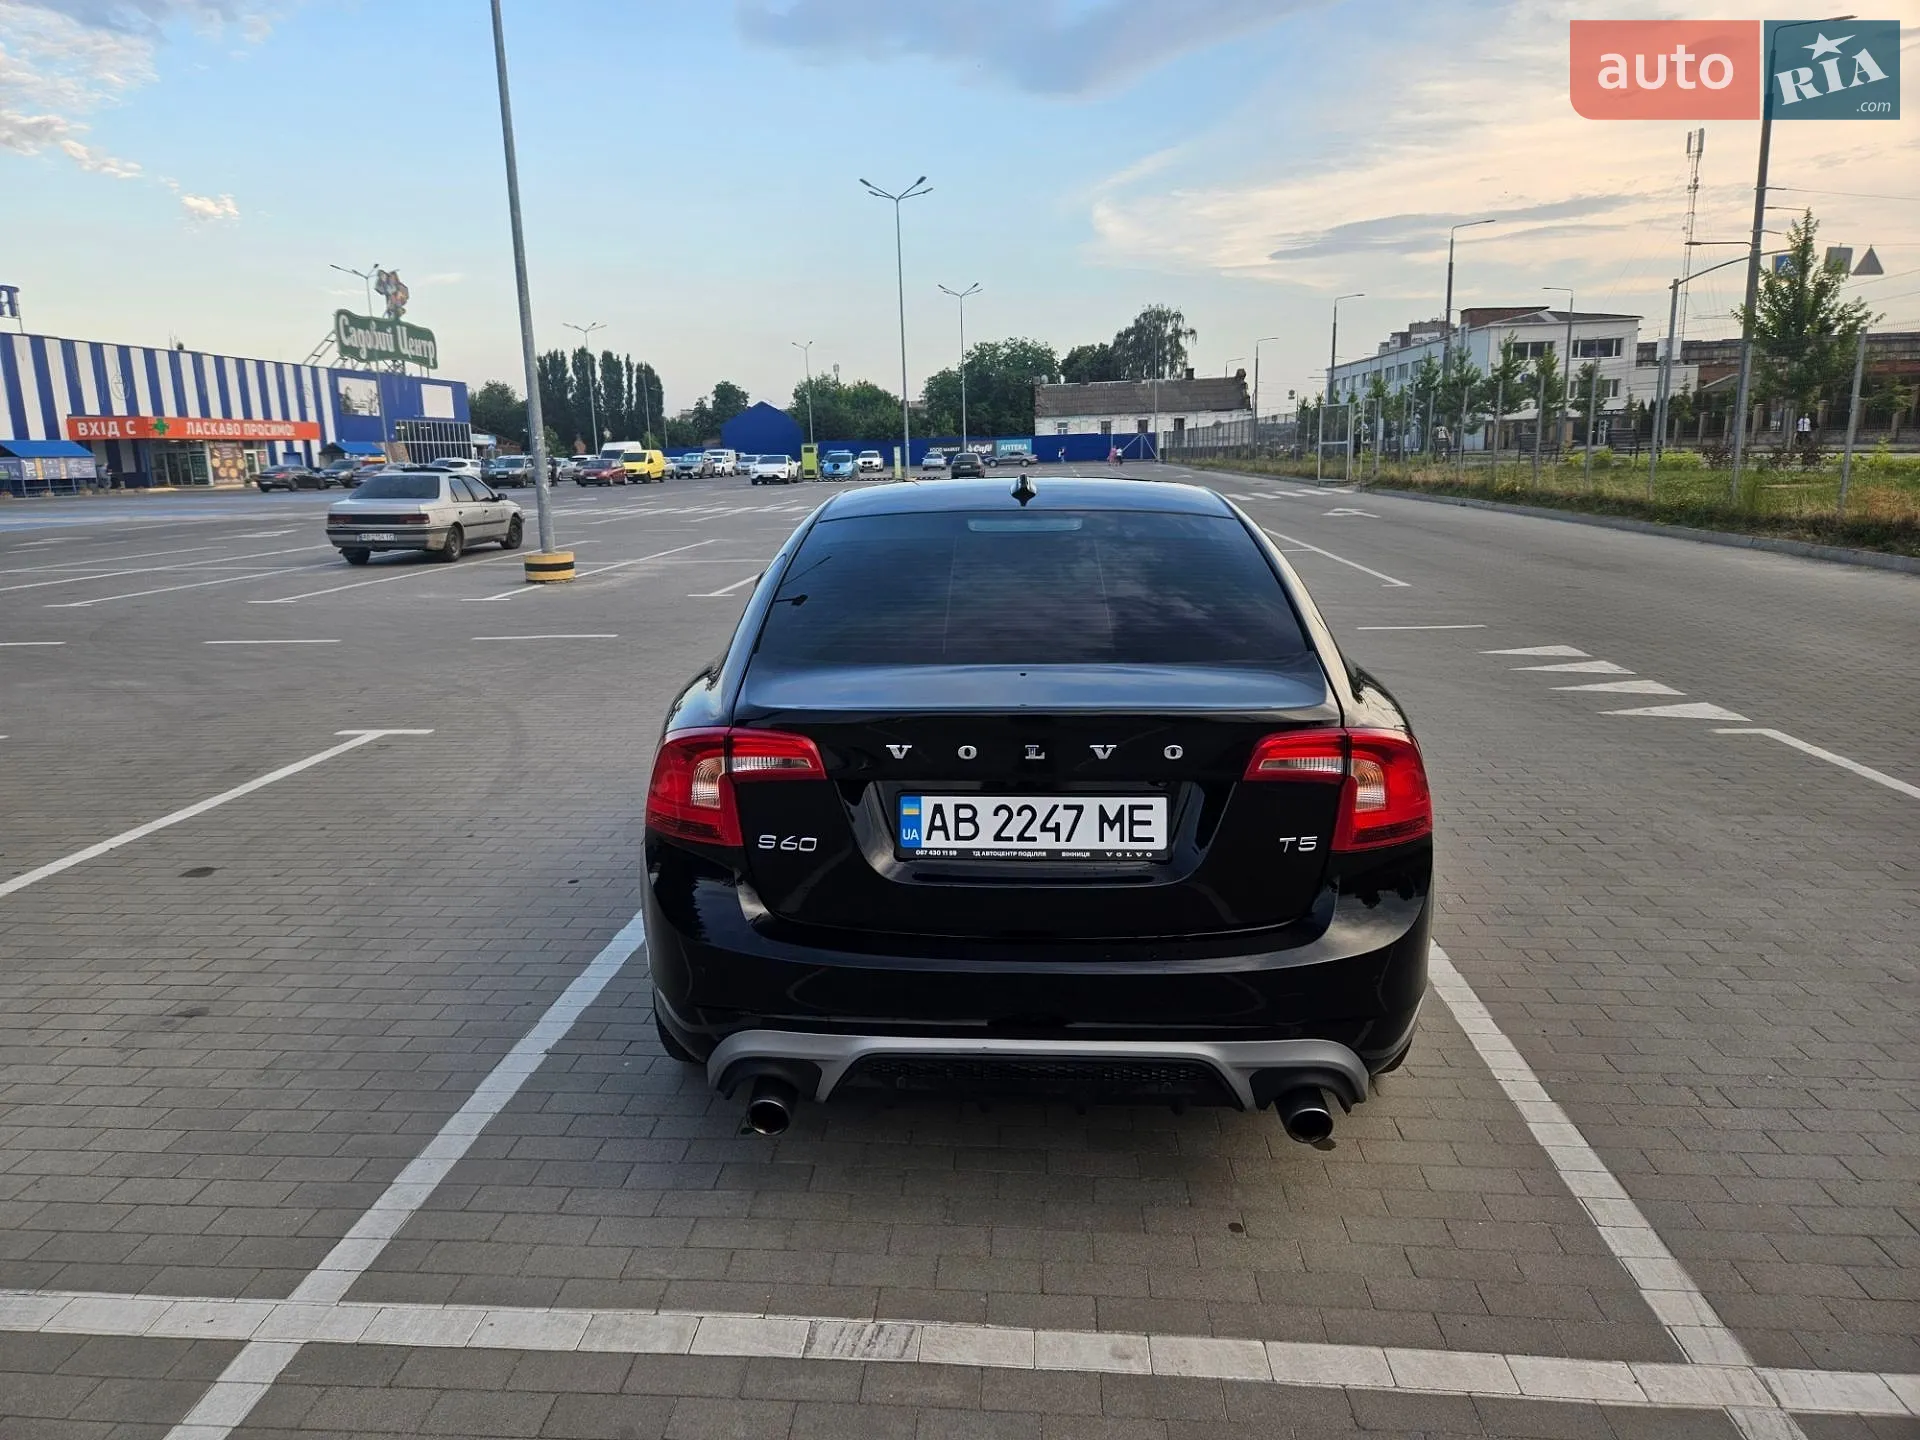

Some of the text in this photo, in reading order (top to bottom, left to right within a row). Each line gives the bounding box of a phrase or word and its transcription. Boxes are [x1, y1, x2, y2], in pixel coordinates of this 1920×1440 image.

[338, 313, 435, 367] Садовий Центр
[77, 421, 120, 437] ВХІД
[186, 421, 241, 436] ЛАСКАВО
[1000, 443, 1028, 451] АПТЕКА
[886, 744, 1184, 760] VOLVO
[925, 803, 1155, 843] AB 2247 ME
[757, 834, 818, 852] S60
[902, 829, 919, 841] UA
[1279, 836, 1318, 853] T5
